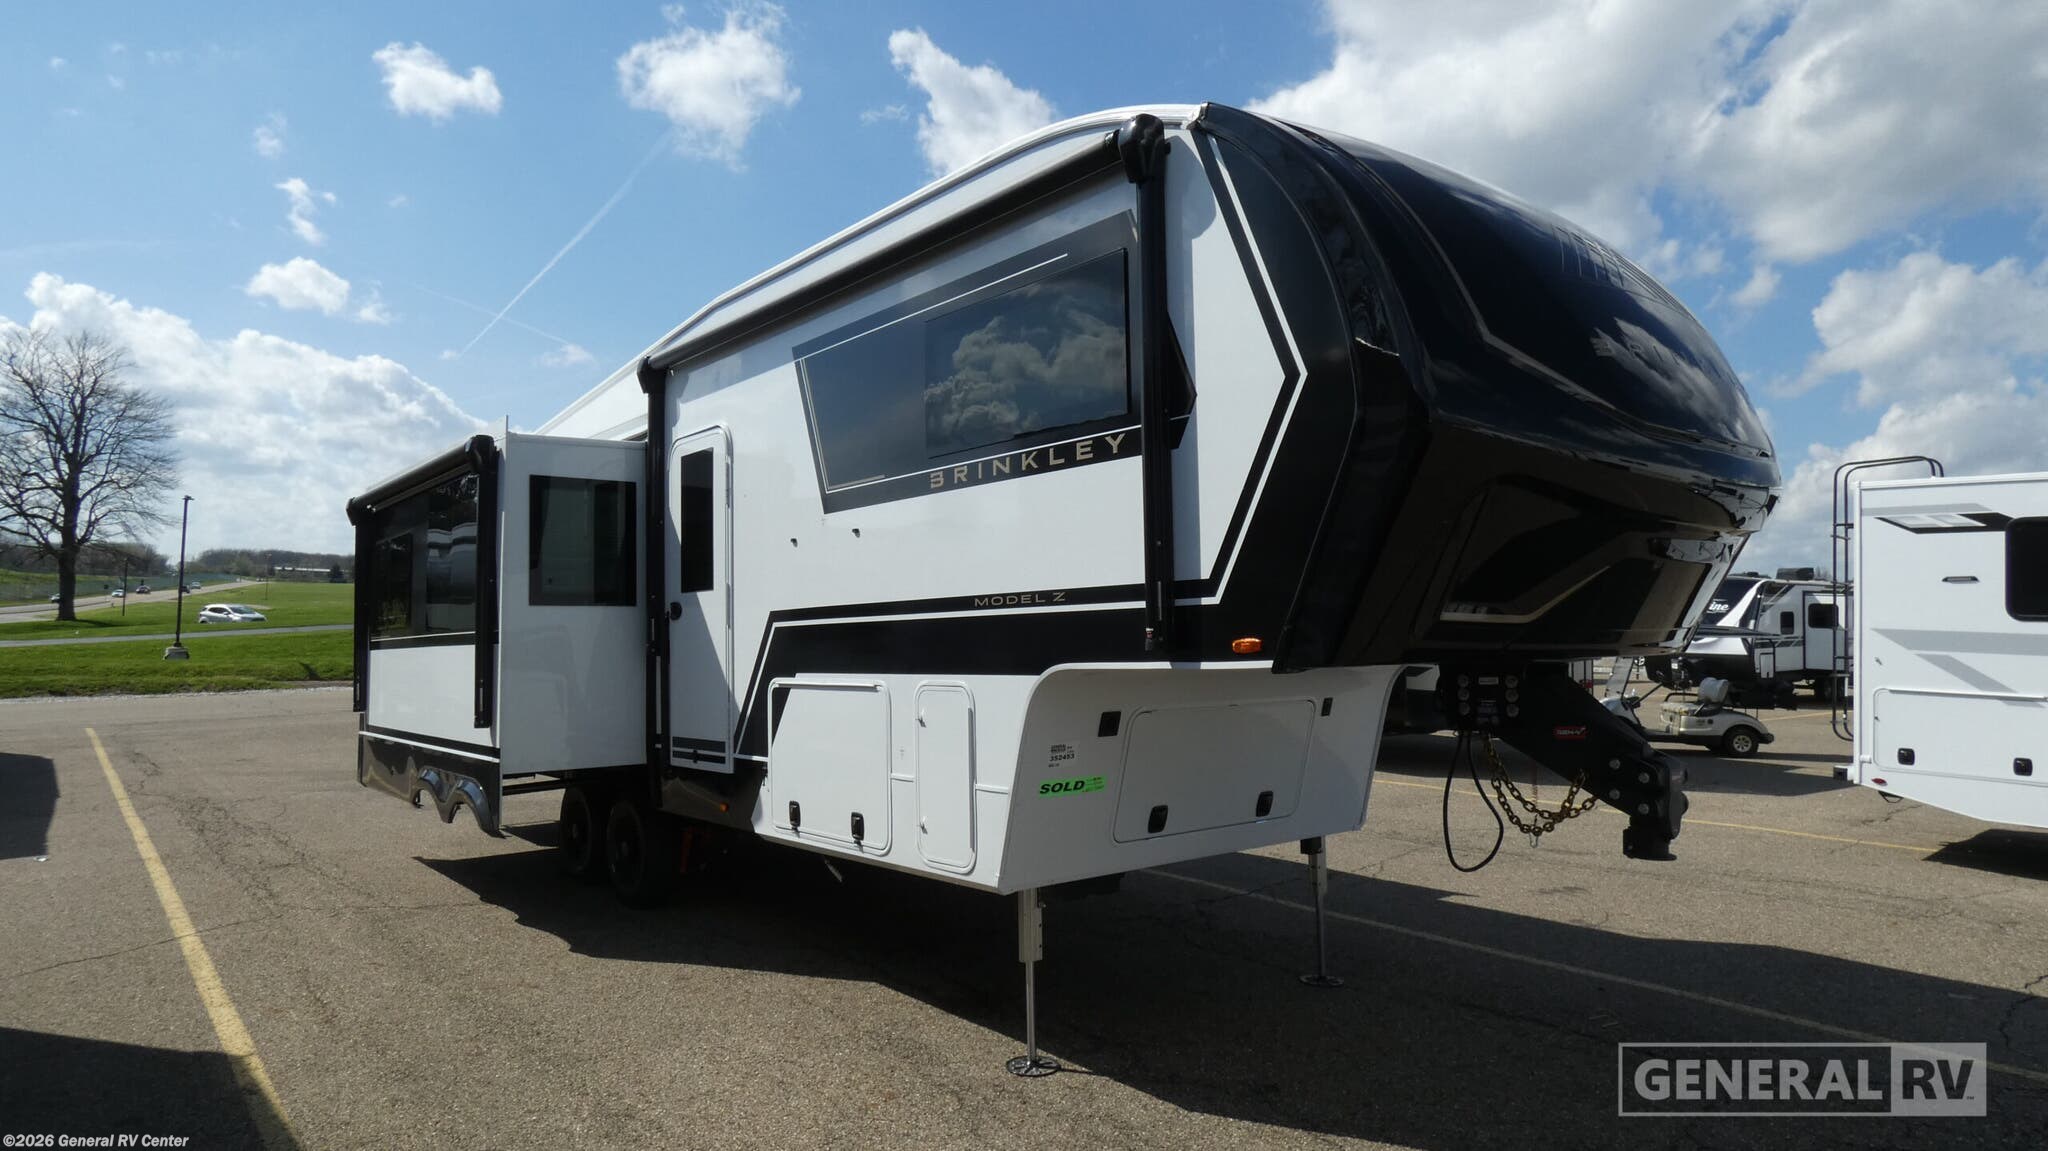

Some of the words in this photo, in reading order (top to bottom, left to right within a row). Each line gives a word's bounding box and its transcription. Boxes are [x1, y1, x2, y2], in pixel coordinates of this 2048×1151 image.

[930, 433, 1126, 488] BRINKLEY
[974, 593, 1046, 607] MODEL
[1052, 592, 1066, 602] Z
[1040, 780, 1085, 794] SOLD
